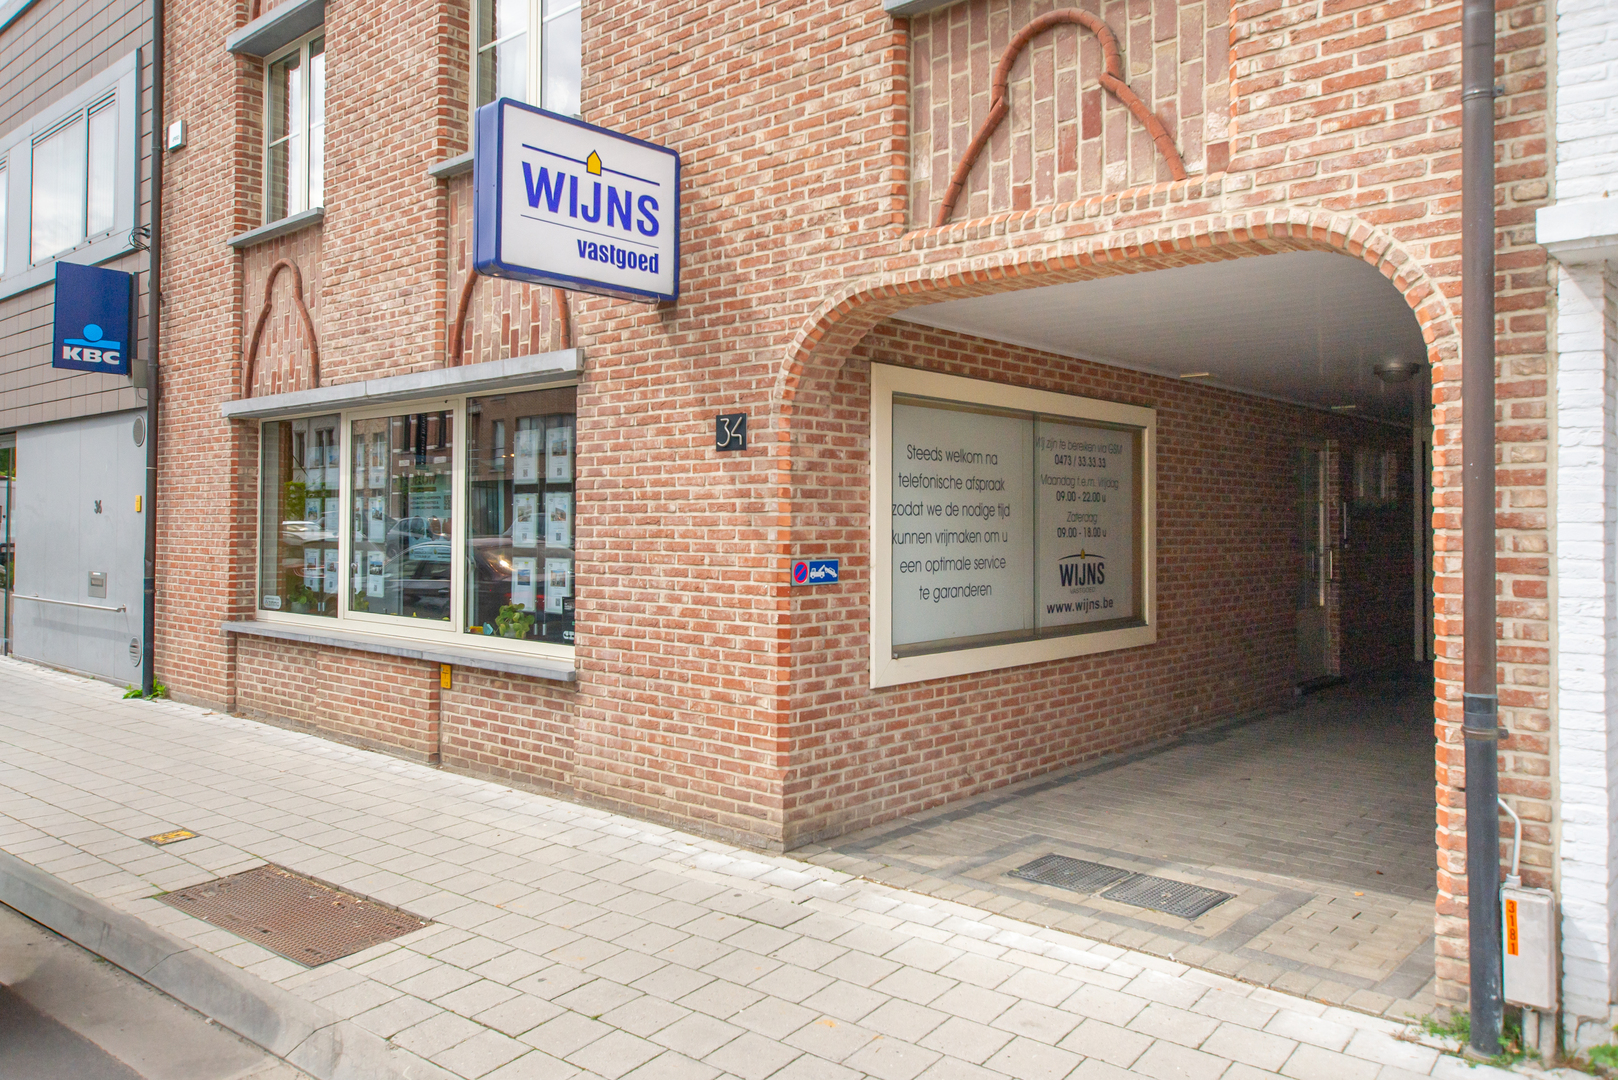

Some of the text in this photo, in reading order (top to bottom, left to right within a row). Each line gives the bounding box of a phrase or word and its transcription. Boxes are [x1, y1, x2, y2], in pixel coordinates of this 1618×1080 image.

[521, 160, 660, 237] WIJNS
[577, 238, 660, 275] vastgoed
[62, 345, 121, 366] KBC
[716, 415, 743, 448] 34
[906, 443, 998, 466] Steeds welkom na
[1046, 438, 1058, 451] zijn
[1059, 438, 1067, 450] te
[1067, 440, 1097, 453] bereiken
[1107, 443, 1123, 455] GSM
[1054, 453, 1072, 466] 0473
[898, 472, 1005, 493] telefonische afspraak
[1040, 473, 1076, 489] Maandag
[1055, 490, 1077, 502] 09.00
[1082, 491, 1101, 503] 22.00
[1101, 493, 1107, 503] u
[892, 501, 1011, 521] zodat we de nodige tijd
[1066, 511, 1098, 525] Zaterdag
[892, 528, 1008, 547] kunnen vrijmaken om u
[1056, 527, 1078, 538] 09.00
[1083, 527, 1101, 538] 18.00
[1102, 528, 1107, 538] u
[900, 555, 1006, 575] een optimale service
[1059, 562, 1105, 587] WIJNS
[918, 583, 993, 603] te garanderen
[1046, 597, 1114, 614] www.wijns.be
[1508, 900, 1516, 955] 3181
